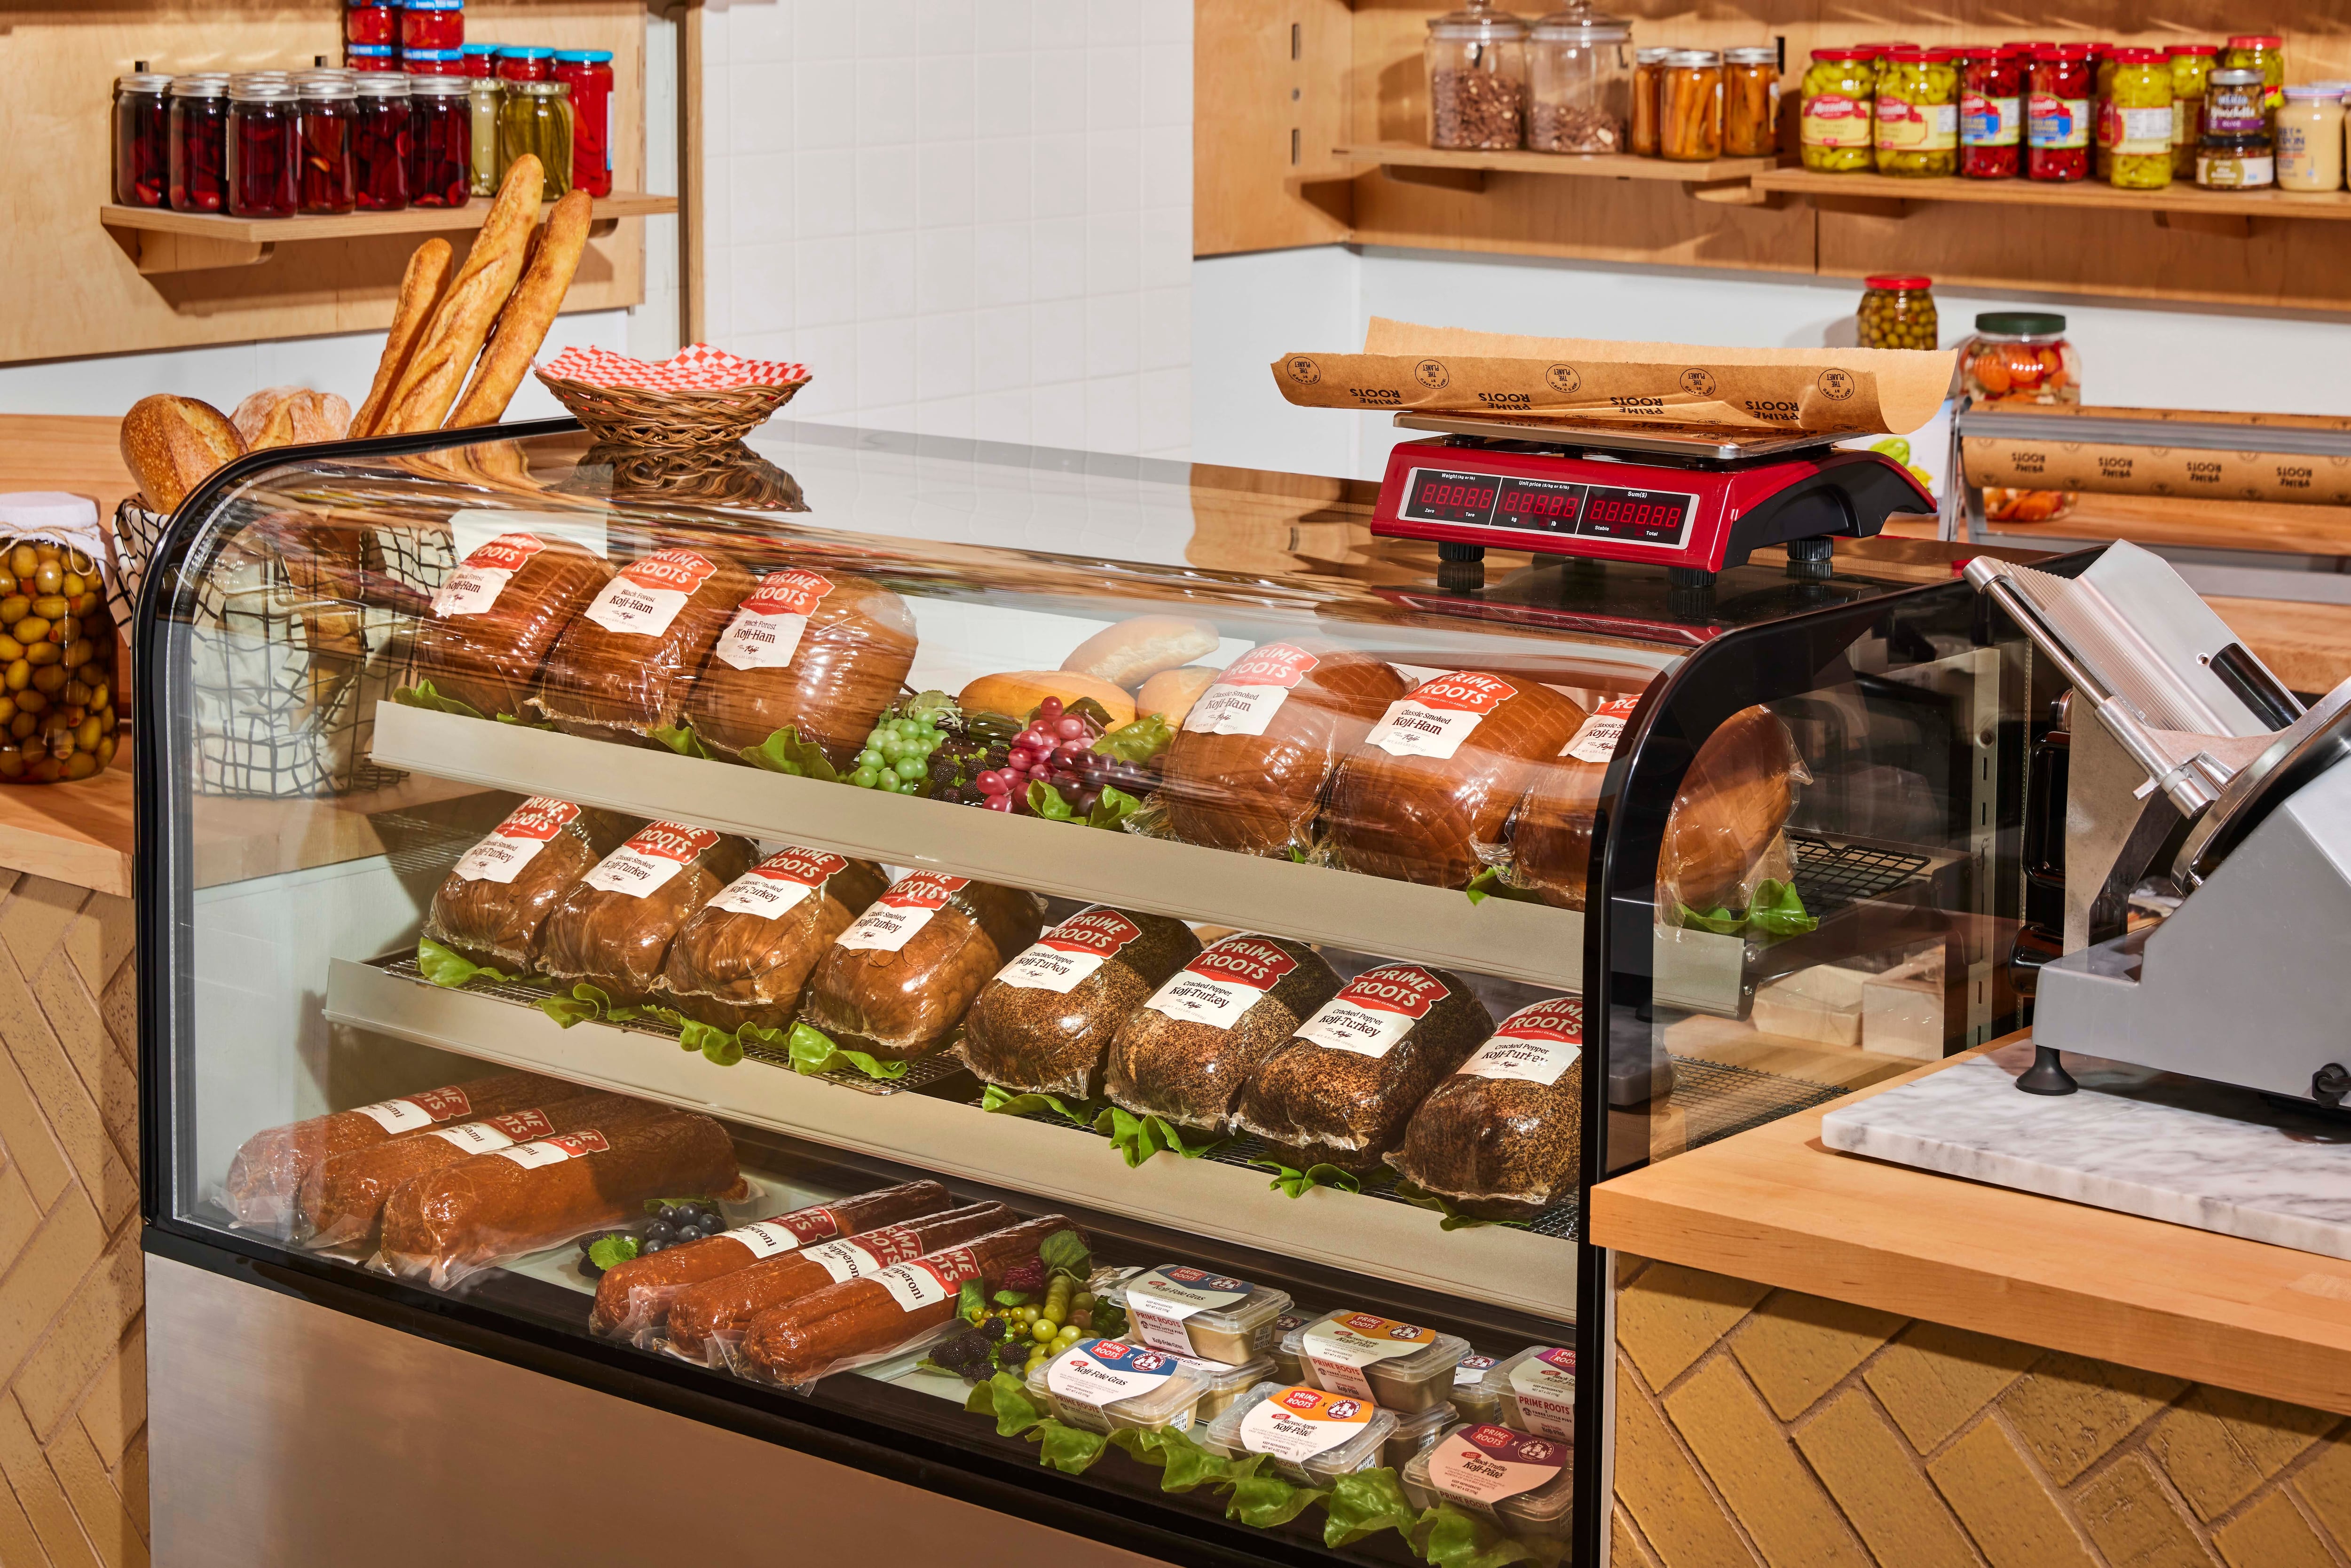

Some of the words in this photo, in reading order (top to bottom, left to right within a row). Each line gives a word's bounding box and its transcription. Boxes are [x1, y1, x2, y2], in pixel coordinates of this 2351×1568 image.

[1350, 388, 1401, 398] ROOTS
[1478, 393, 1531, 402] ROOTS
[1610, 397, 1664, 406] ROOTS
[1745, 401, 1799, 411] ROOTS
[1753, 411, 1799, 420] PRIME
[2012, 452, 2045, 463] ROOTS
[2099, 457, 2133, 468] ROOTS
[2187, 462, 2222, 472] ROOTS
[2277, 466, 2312, 478] ROOTS
[648, 551, 703, 570] PRIME
[631, 562, 691, 583] ROOTS
[447, 581, 481, 593] Koji-Ham
[766, 573, 821, 590] PRIME
[609, 595, 653, 614] Koji-Ham
[638, 593, 656, 602] Forest
[751, 587, 809, 606] ROOTS
[734, 629, 775, 644] Koji-Ham
[1227, 662, 1291, 678] ROOTS
[1437, 673, 1503, 693] PRIME
[1418, 685, 1488, 704] ROOTS
[1205, 698, 1251, 712] Koji-Ham
[1401, 709, 1424, 718] Classic
[1423, 713, 1452, 725] Smoked
[1392, 717, 1442, 735] Koji-Ham
[504, 812, 553, 831] ROOTS
[636, 829, 692, 853] ROOTS
[471, 847, 514, 863] Koji-Turkey
[761, 858, 820, 878] ROOTS
[890, 881, 943, 899] ROOTS
[1068, 916, 1128, 935] PRIME
[1050, 928, 1112, 948] ROOTS
[1053, 953, 1074, 965] Pepper
[1219, 942, 1284, 966] PRIME
[1200, 953, 1269, 979] ROOTS
[1183, 981, 1210, 989] Cracked
[1209, 985, 1232, 996] Pepper
[1371, 970, 1436, 992] PRIME
[1168, 987, 1230, 1009] Koji-Turkey
[1350, 982, 1421, 1007] ROOTS
[1333, 1009, 1359, 1017] Cracked
[1360, 1013, 1384, 1025] Pepper
[1318, 1015, 1381, 1037] Koji-Turkey
[1508, 1016, 1582, 1035] ROOTS
[1523, 1044, 1549, 1055] Pepper
[823, 1243, 859, 1277] Pepperon
[1136, 1311, 1157, 1322] PRIME
[1157, 1317, 1181, 1328] ROOTS
[1350, 1320, 1375, 1329] ROOTS
[1357, 1316, 1381, 1325] PRIME
[1094, 1347, 1120, 1358] ROOTS
[1102, 1343, 1126, 1353] PRIME
[1074, 1366, 1109, 1380] Koji-Foie
[1312, 1358, 1335, 1369] PRIME
[1335, 1364, 1360, 1375] ROOTS
[1286, 1398, 1314, 1408] ROOTS
[1294, 1392, 1318, 1403] PRIME
[1519, 1396, 1543, 1408] PRIME
[1544, 1402, 1570, 1415] ROOTS
[1281, 1418, 1302, 1427] Harvest
[1475, 1434, 1503, 1446] ROOTS
[1483, 1428, 1508, 1440] PRIME
[1462, 1461, 1503, 1479] Koji-Pâté
[1472, 1458, 1489, 1467] Black
[1488, 1462, 1507, 1472] Truffle
[1439, 1490, 1464, 1504] PRIME
[1464, 1497, 1490, 1511] ROOTS
